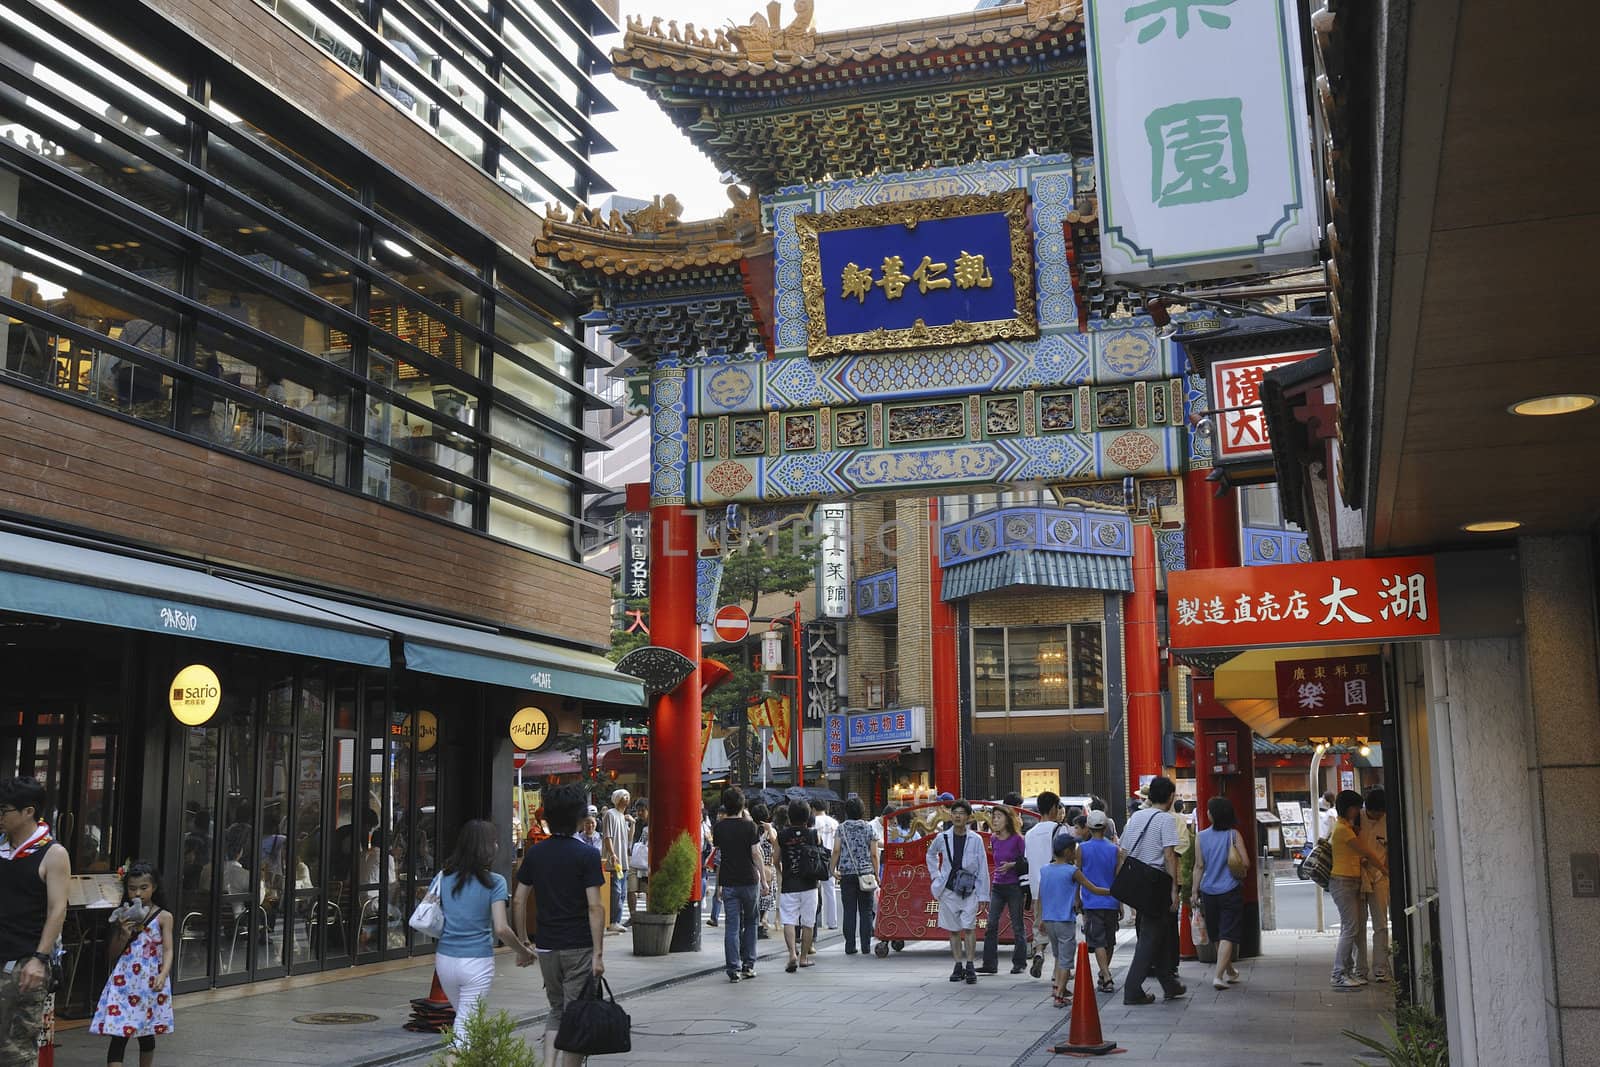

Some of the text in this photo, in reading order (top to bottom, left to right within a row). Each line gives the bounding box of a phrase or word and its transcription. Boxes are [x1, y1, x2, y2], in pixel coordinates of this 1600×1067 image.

[630, 524, 648, 598] 中国名菜
[1175, 572, 1429, 627] 製造直売店 太湖
[185, 684, 217, 699] sario
[1297, 677, 1368, 710] 樂園
[525, 722, 547, 736] CAFE
